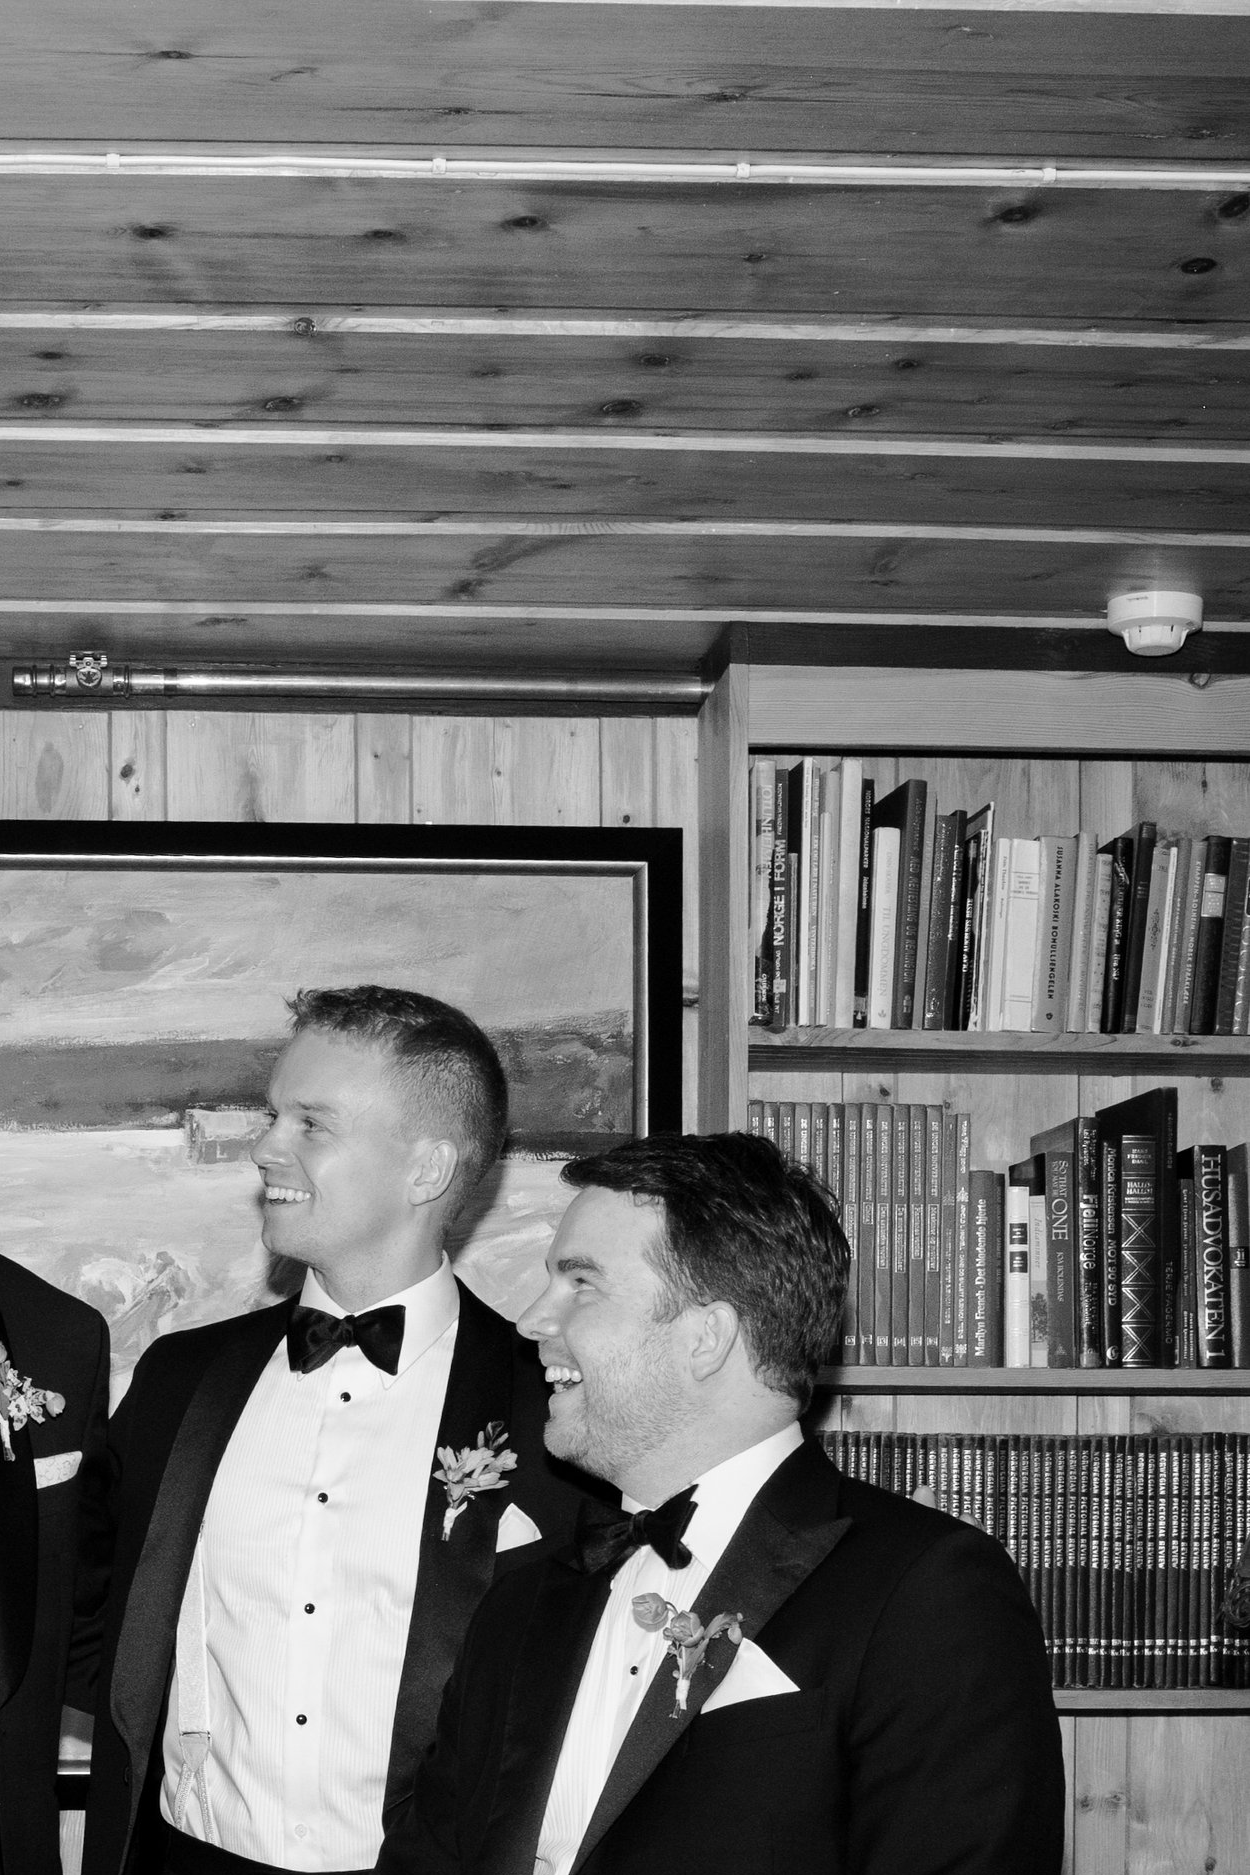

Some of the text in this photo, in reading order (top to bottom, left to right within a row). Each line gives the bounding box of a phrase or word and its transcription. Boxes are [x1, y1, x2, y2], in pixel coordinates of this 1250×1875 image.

[775, 839, 788, 880] FORM
[1055, 846, 1064, 880] SUSANNA
[774, 894, 785, 945] NORGE
[1052, 883, 1061, 922] ALAKOSKI
[1107, 1148, 1117, 1182] Monica
[1058, 1174, 1067, 1197] THAT
[977, 1199, 988, 1225] hjerte
[1052, 1198, 1069, 1240] ONE
[1107, 1183, 1117, 1234] Kristensen
[1108, 1239, 1117, 1263] MOT
[1201, 1154, 1225, 1359] HUSADVOKATEN 1
[975, 1270, 985, 1285] Det
[1108, 1283, 1116, 1306] SYD
[975, 1290, 985, 1319] French
[974, 1322, 986, 1357] Marilyn
